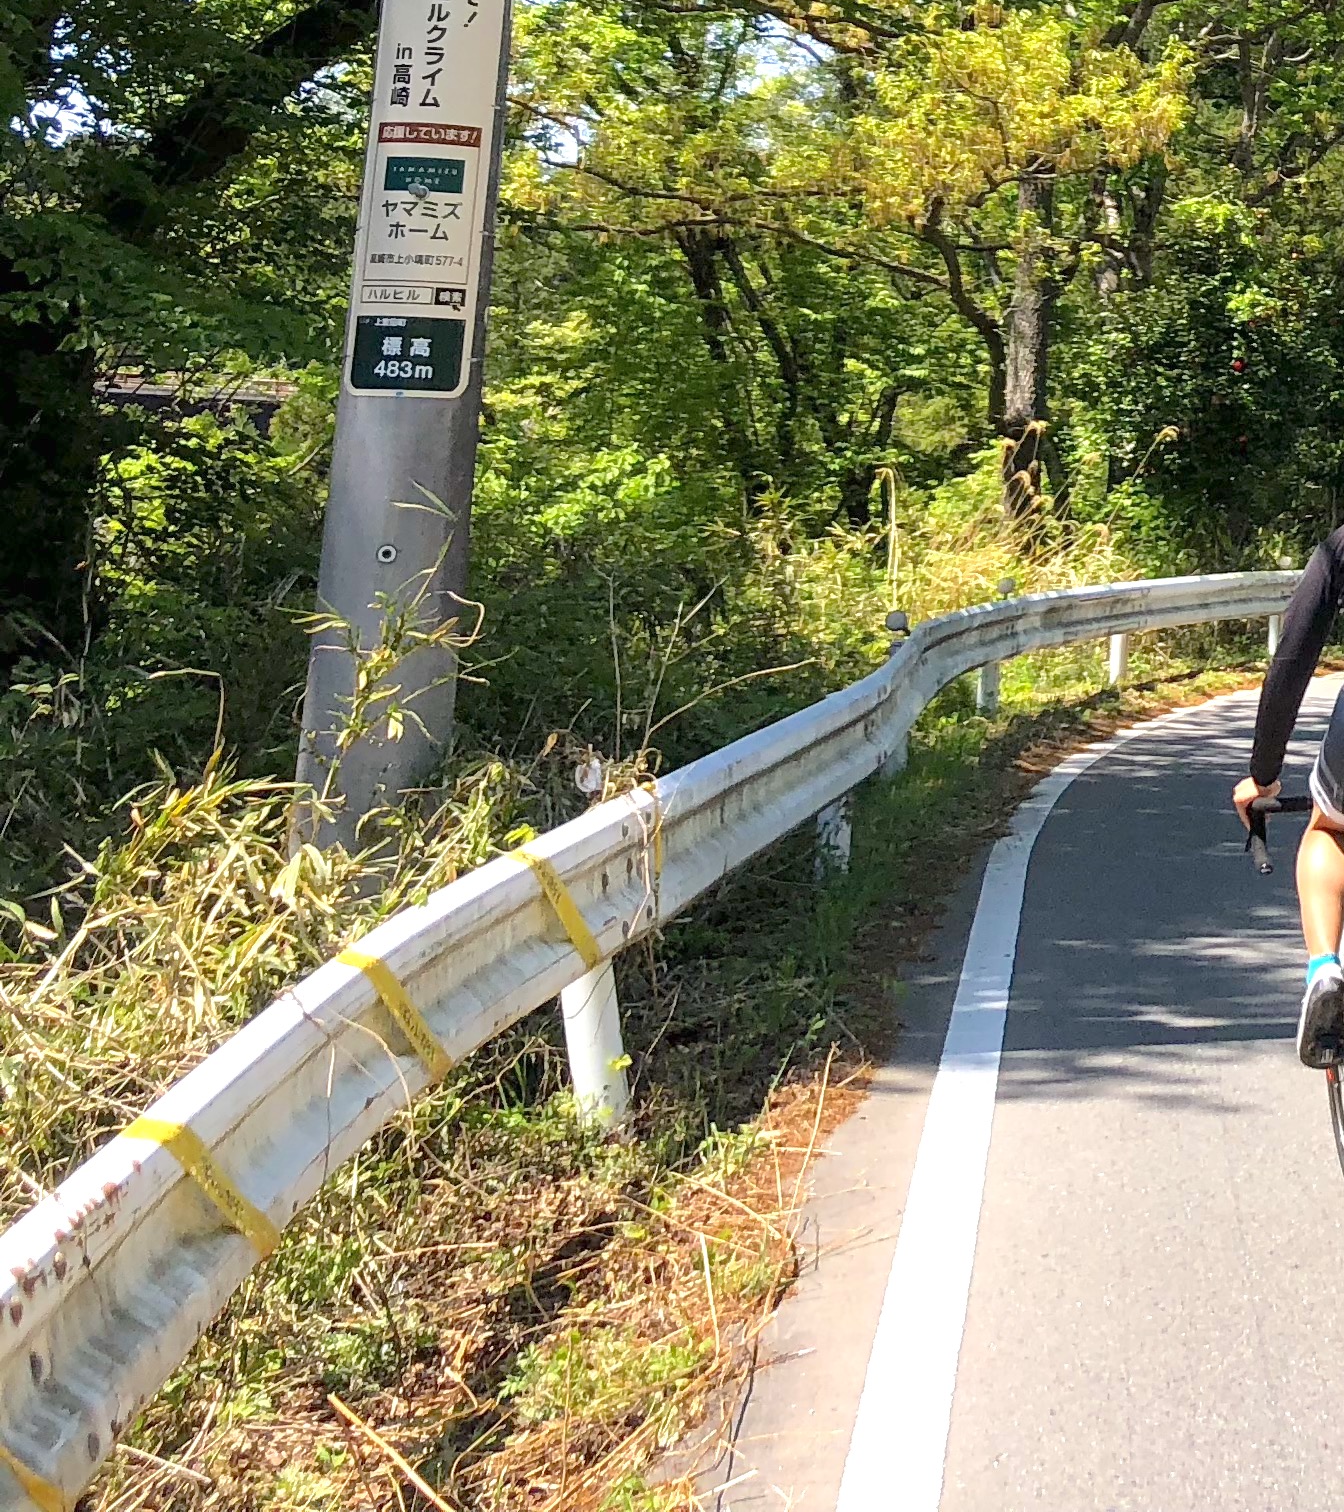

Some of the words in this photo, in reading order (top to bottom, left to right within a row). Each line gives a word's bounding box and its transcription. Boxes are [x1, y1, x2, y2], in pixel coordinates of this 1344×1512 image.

[381, 199, 463, 221] ヤマミズ
[387, 222, 449, 241] ホーム
[367, 289, 421, 301] ハルヒル
[373, 360, 434, 379] 483m
